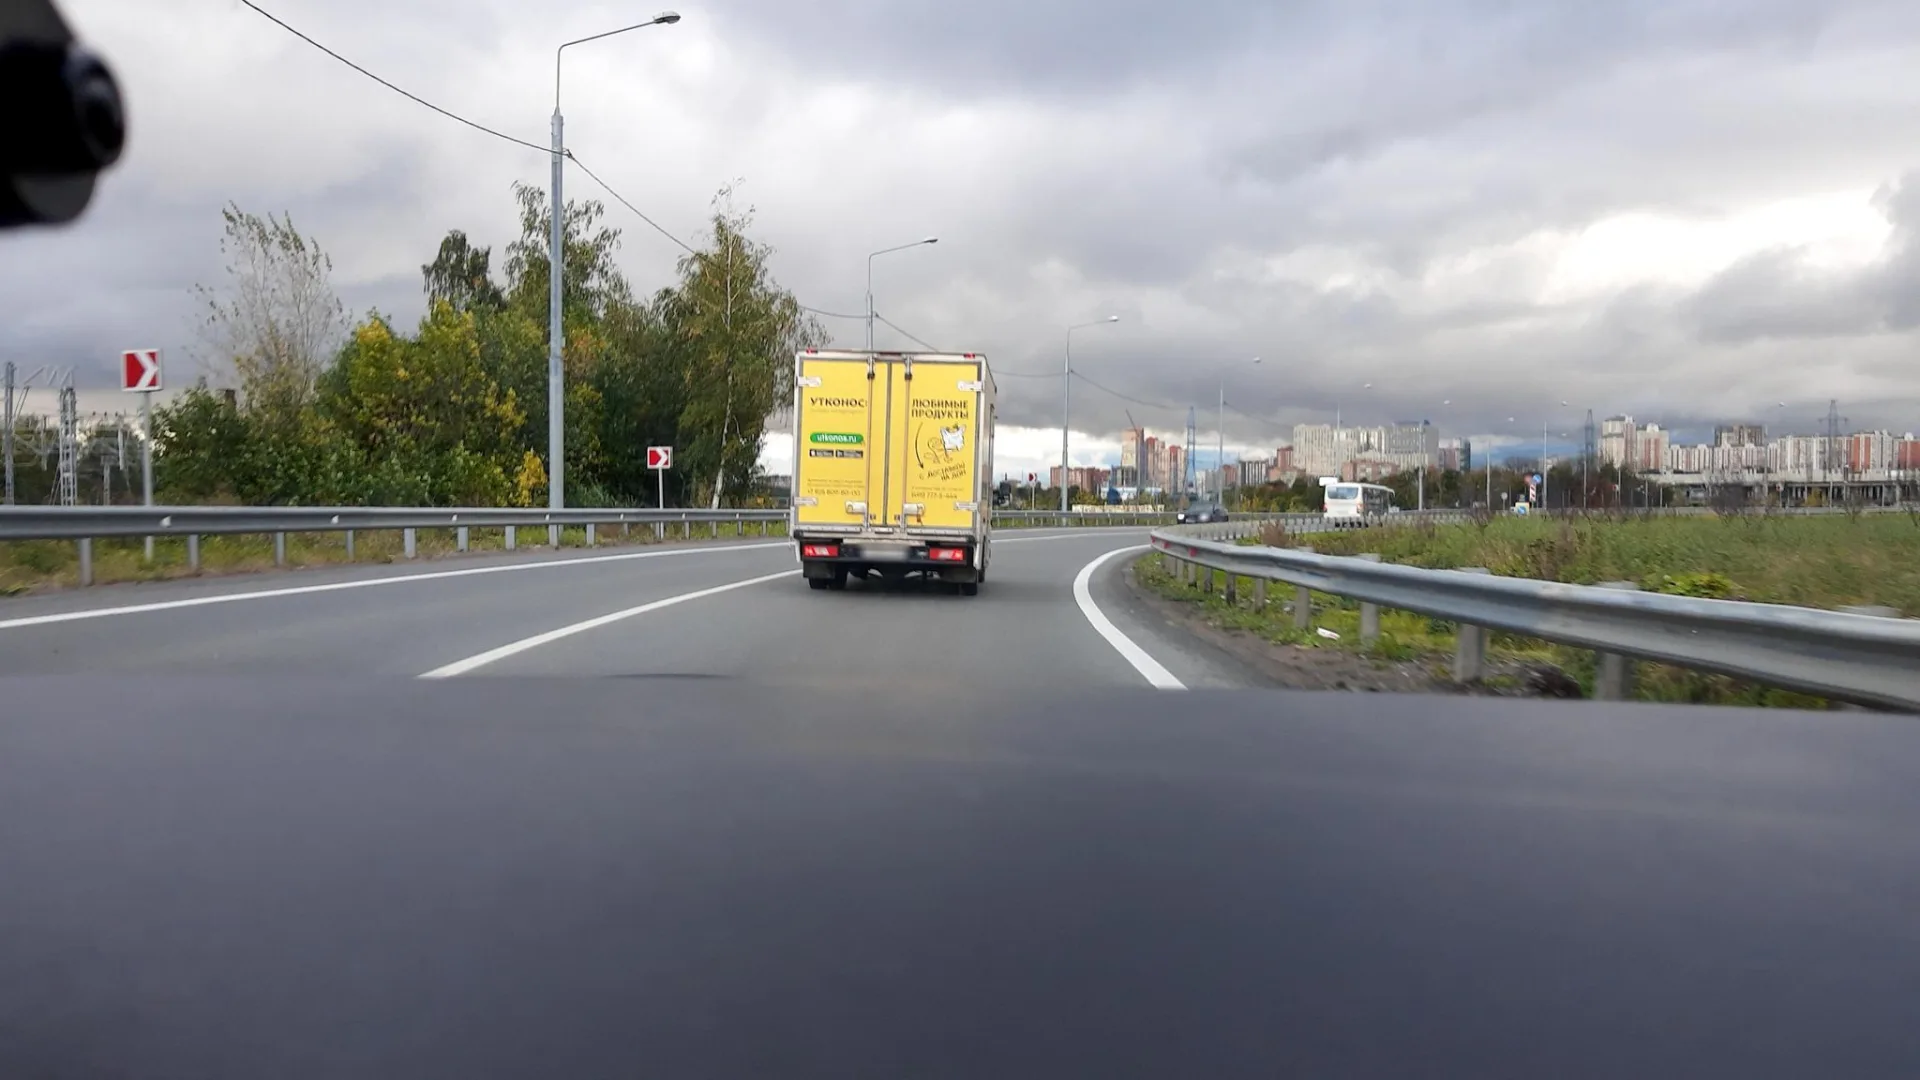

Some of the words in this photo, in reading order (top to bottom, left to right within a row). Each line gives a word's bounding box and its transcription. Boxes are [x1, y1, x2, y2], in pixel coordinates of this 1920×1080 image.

[810, 397, 865, 408] УТКОНОС
[912, 399, 968, 409] ЛЮБИМЫЕ
[911, 409, 968, 420] ПРОДУКТЫ
[816, 434, 857, 443] utkonos.ru
